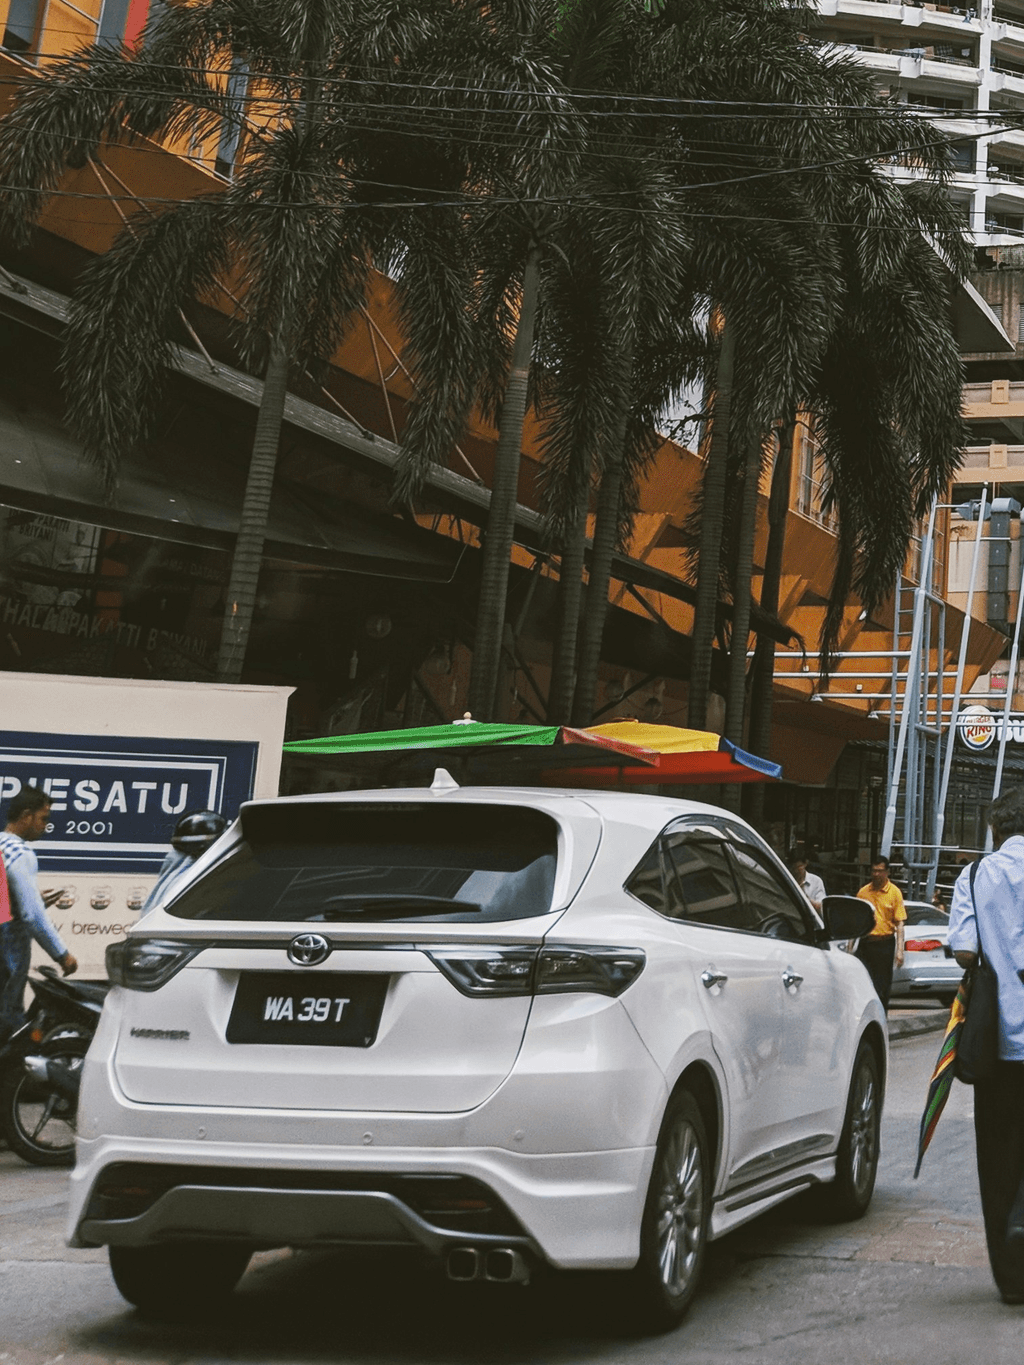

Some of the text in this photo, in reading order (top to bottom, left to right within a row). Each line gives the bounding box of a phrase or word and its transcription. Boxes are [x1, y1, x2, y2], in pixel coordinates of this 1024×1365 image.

[66, 820, 113, 835] 2001
[264, 996, 350, 1022] WA 39 T
